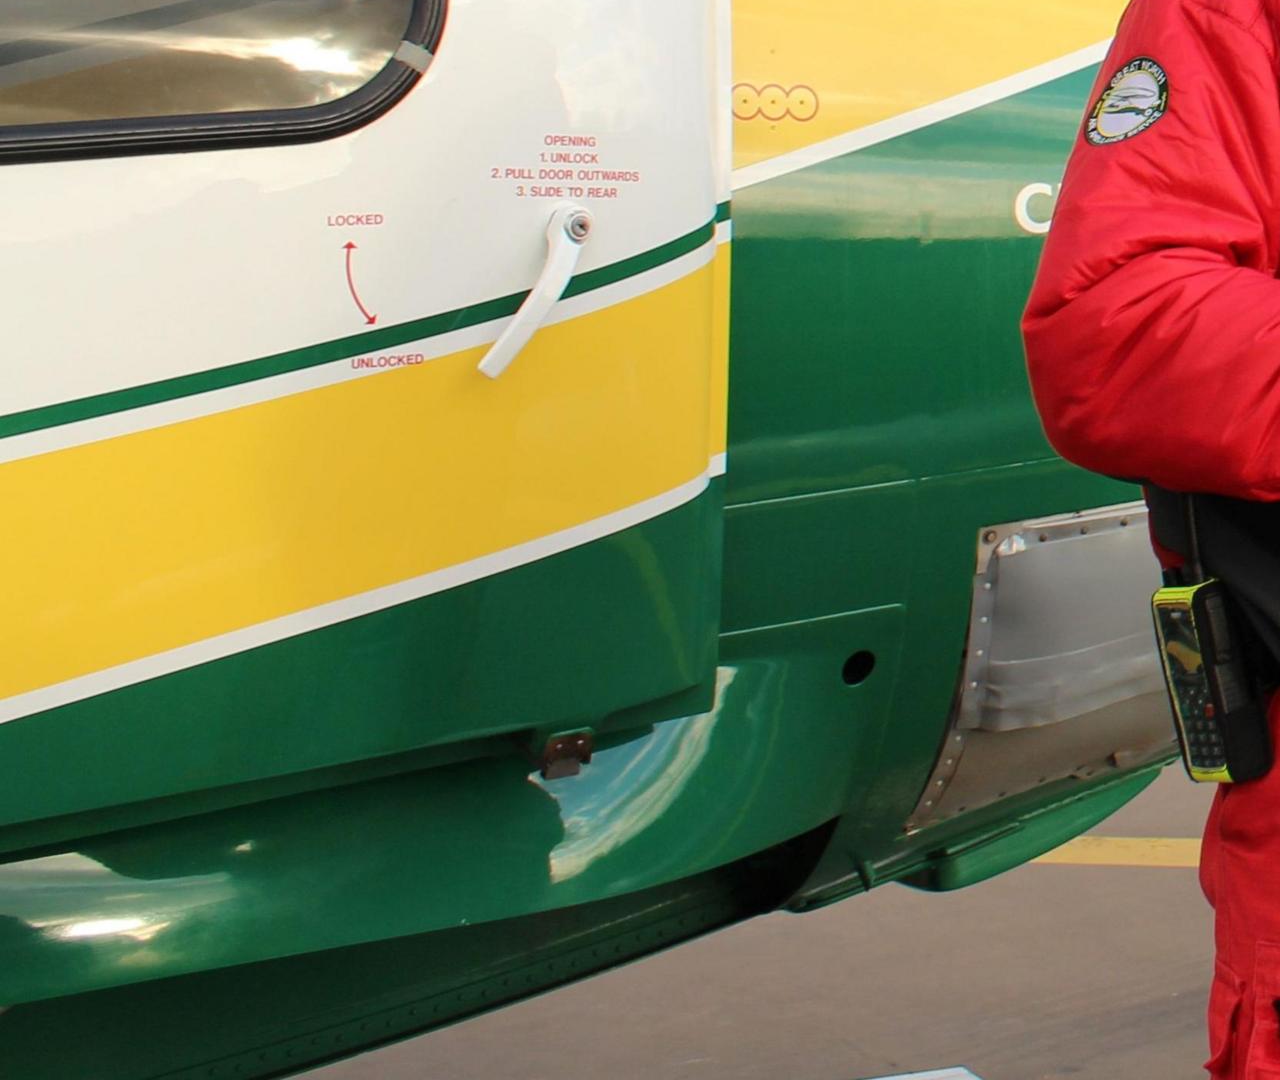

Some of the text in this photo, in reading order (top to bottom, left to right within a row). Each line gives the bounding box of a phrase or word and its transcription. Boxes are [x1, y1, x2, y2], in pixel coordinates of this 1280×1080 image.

[544, 135, 597, 147] OPENING
[540, 153, 599, 164] 1. UNLOCK
[491, 168, 640, 182] 2. PULL DOOR OUTWARDS
[516, 186, 618, 198] 3. SLIDE TO REAR
[328, 214, 384, 227] LOCKED
[351, 354, 424, 369] UNLOCKED
